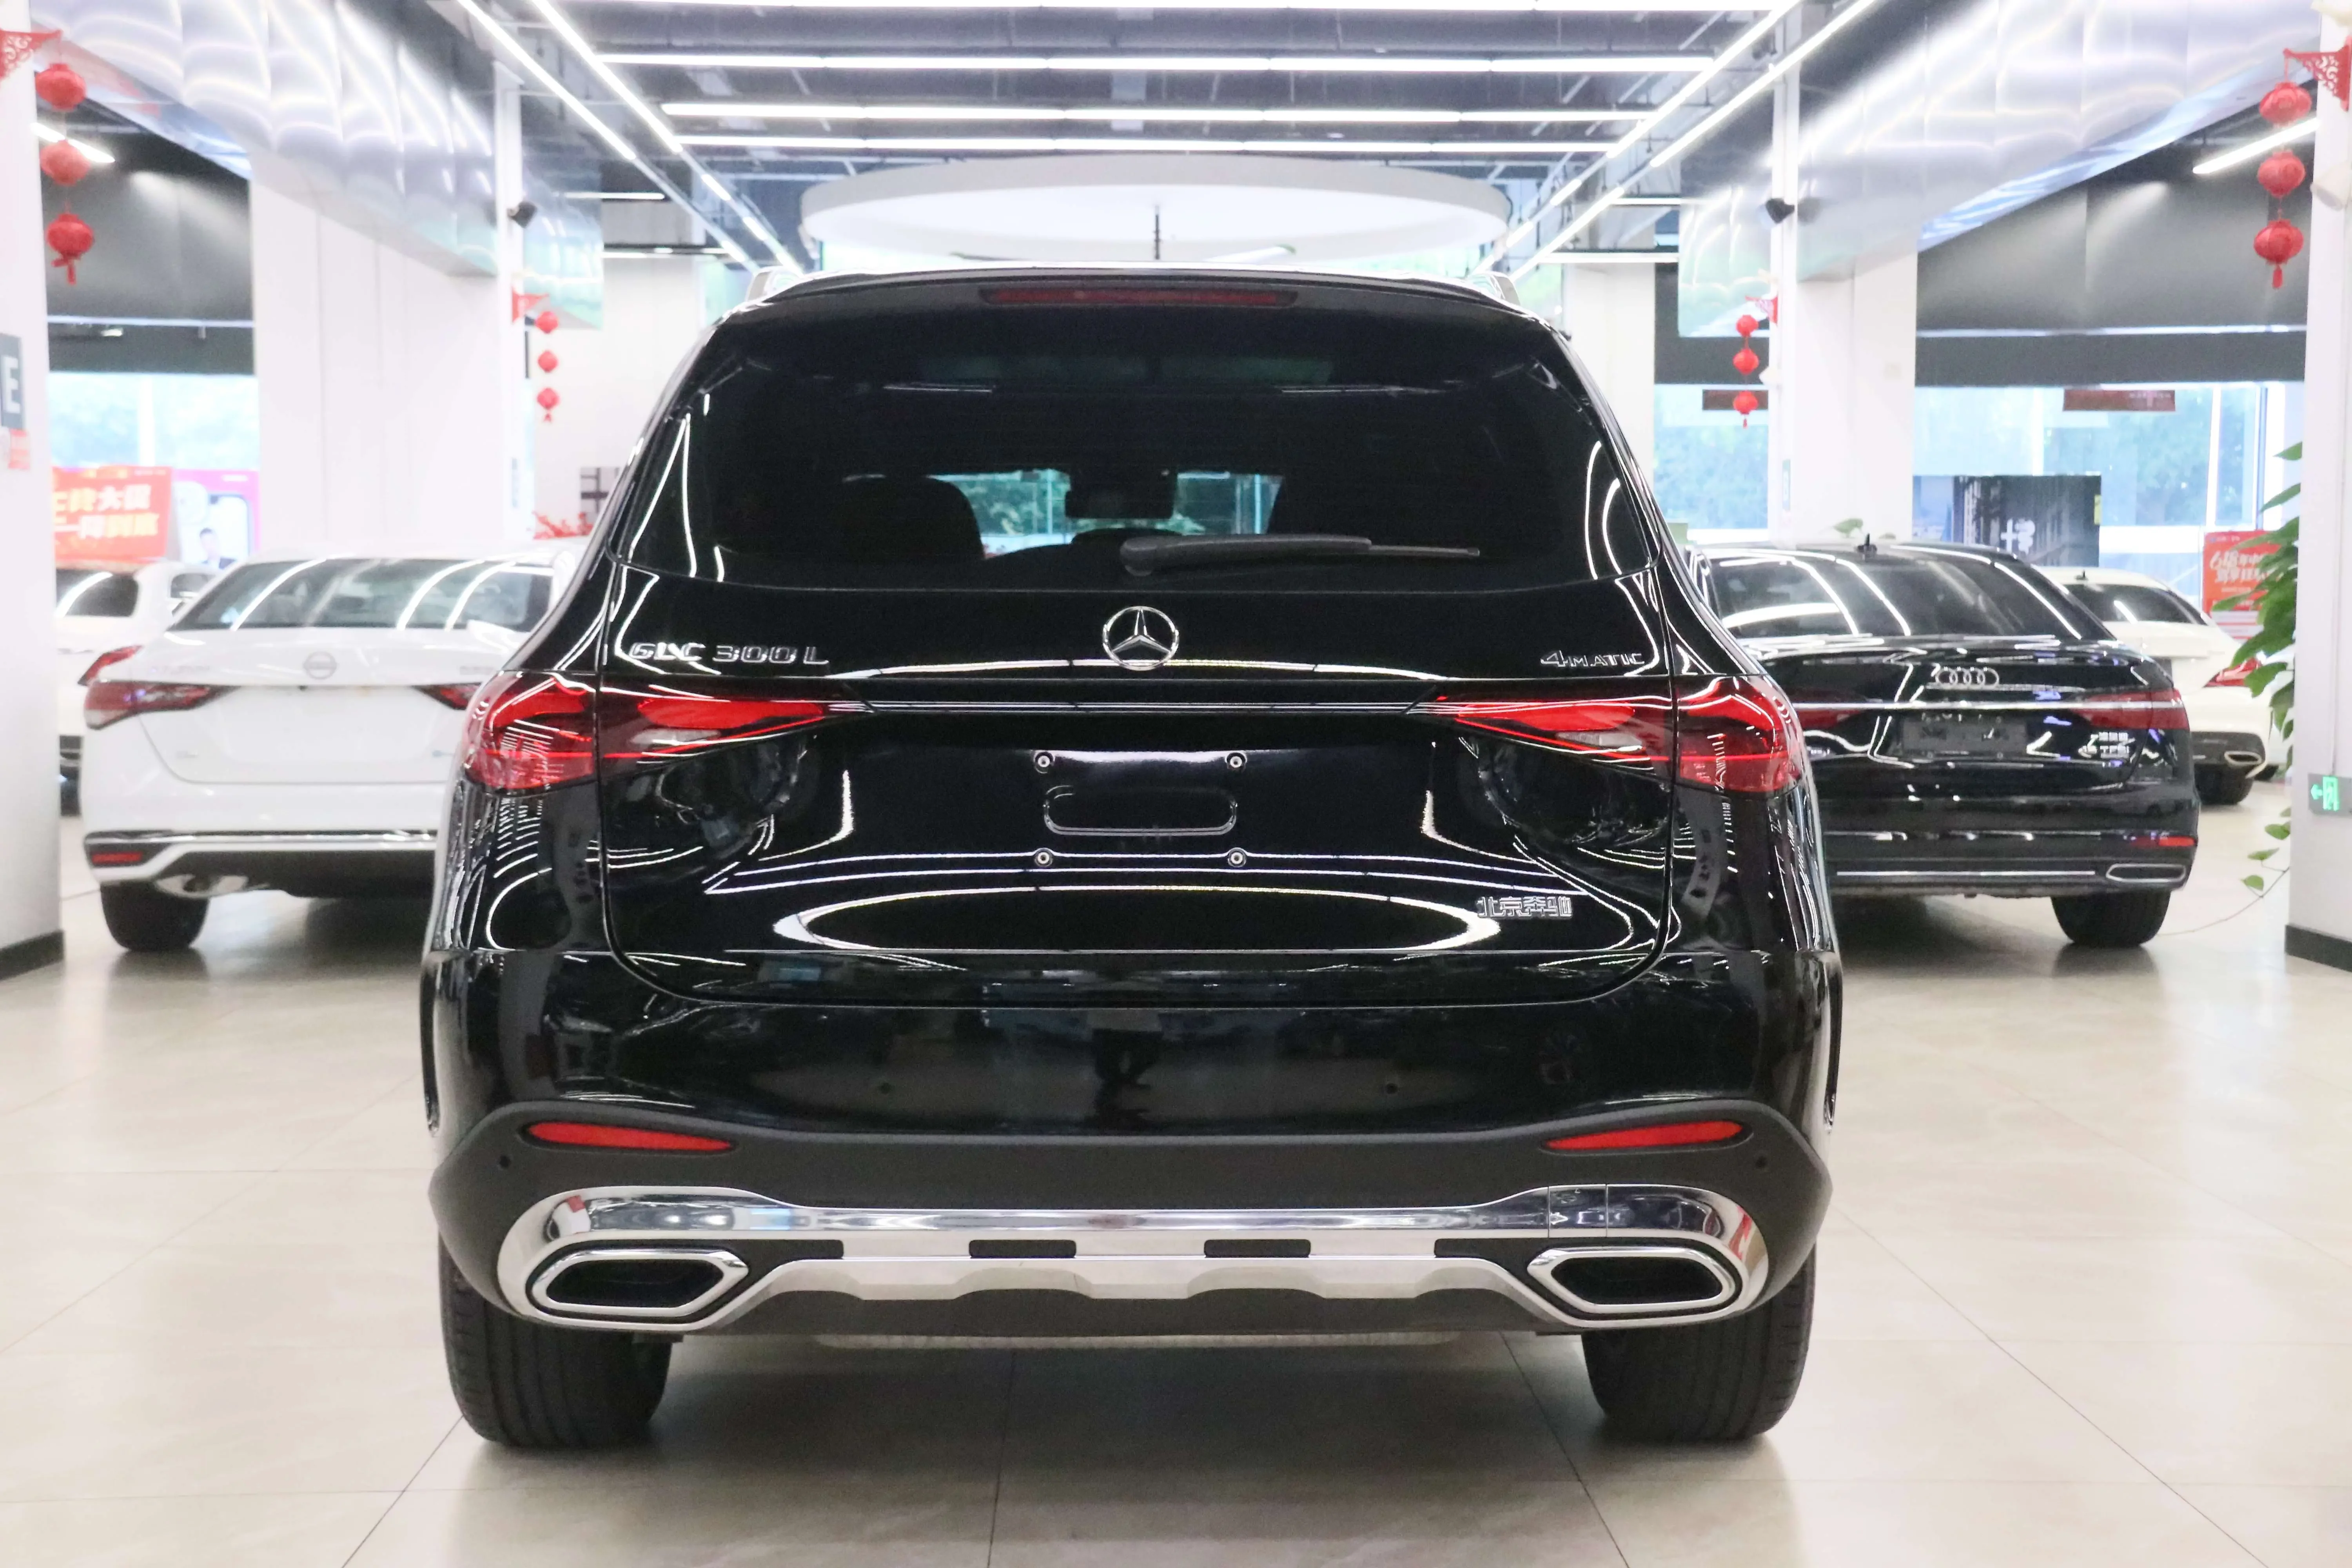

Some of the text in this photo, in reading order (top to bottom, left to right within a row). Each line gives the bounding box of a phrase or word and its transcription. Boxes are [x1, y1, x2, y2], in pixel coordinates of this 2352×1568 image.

[628, 642, 829, 665] GLC 300 L
[1540, 650, 1645, 667] 4MATIC
[1476, 896, 1573, 918] 北京奔驰
